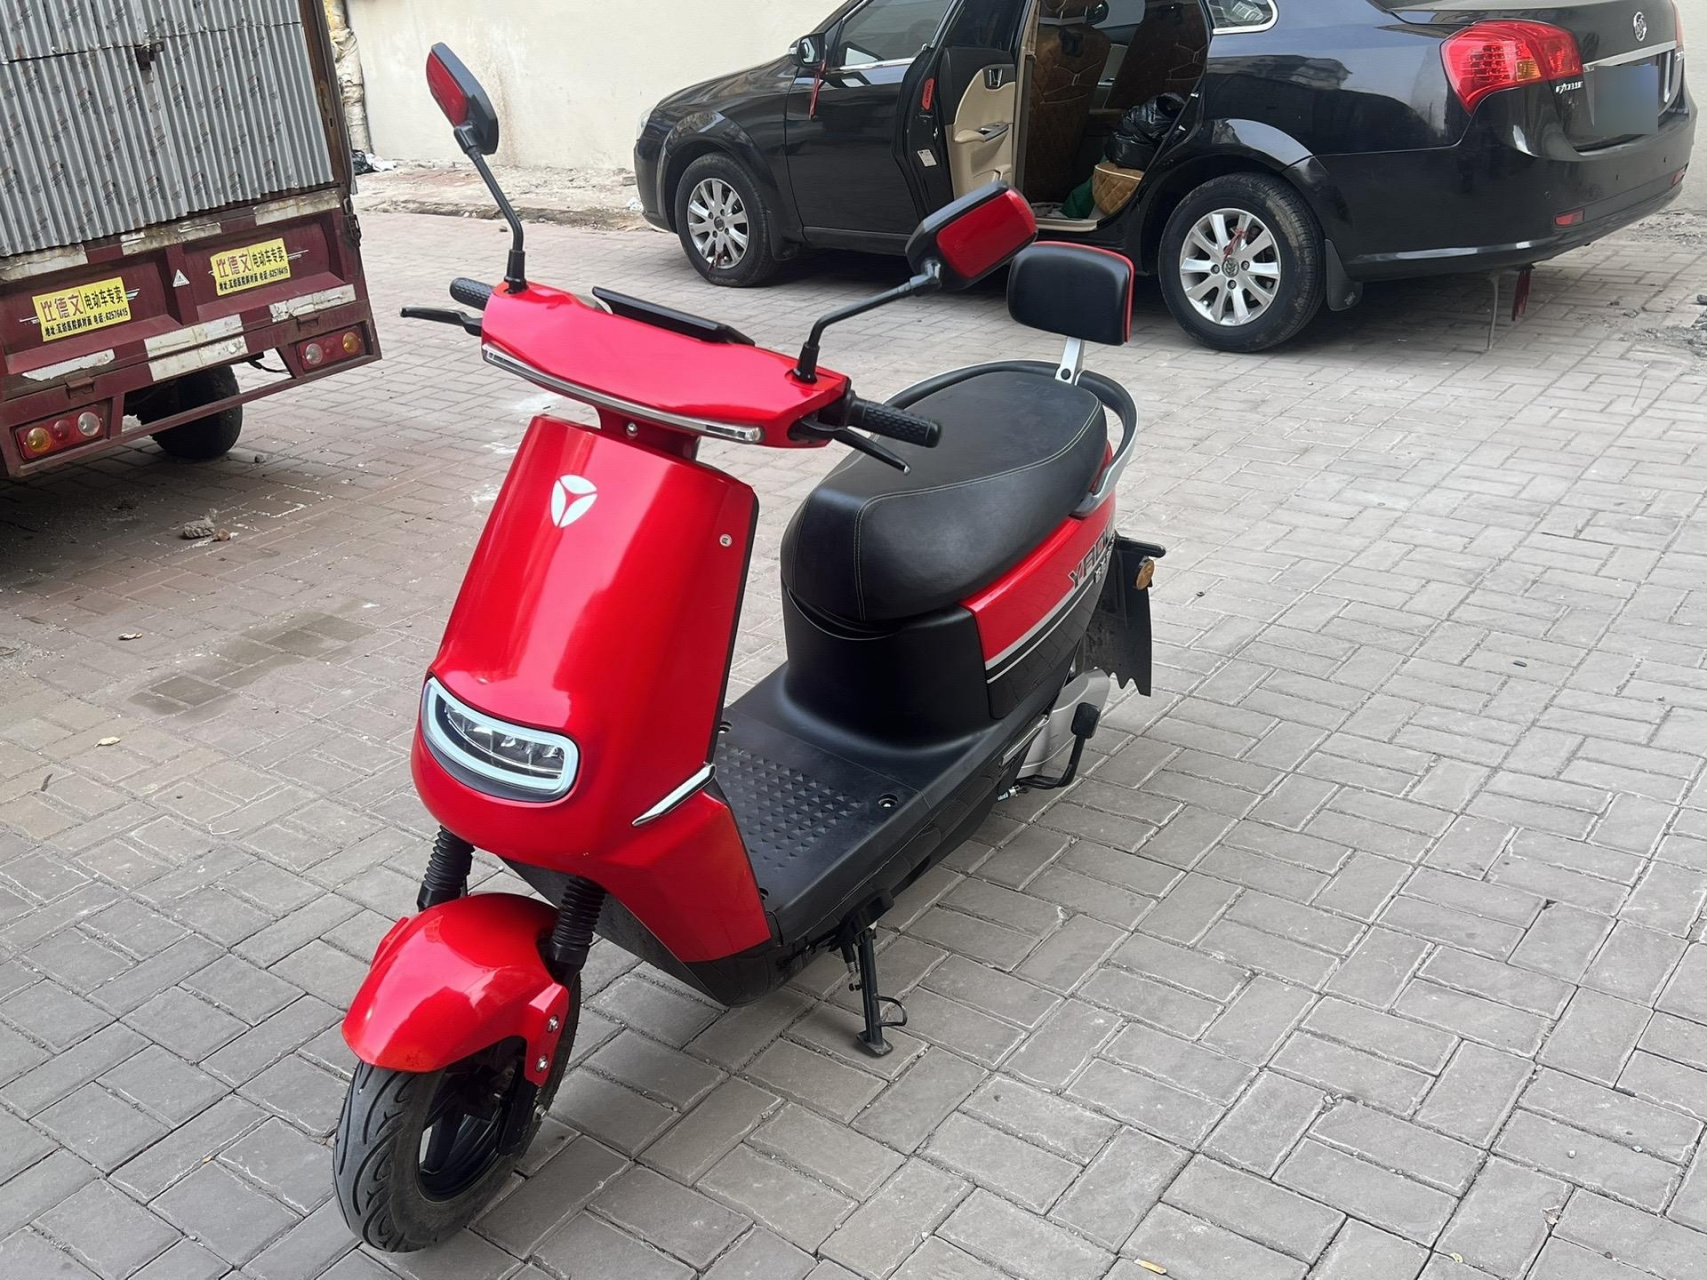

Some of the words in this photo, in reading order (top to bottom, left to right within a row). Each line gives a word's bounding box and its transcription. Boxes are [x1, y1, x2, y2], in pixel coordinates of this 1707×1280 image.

[216, 253, 252, 278] 比德文
[40, 294, 84, 323] 比德文
[84, 285, 124, 310] 电动车专卖
